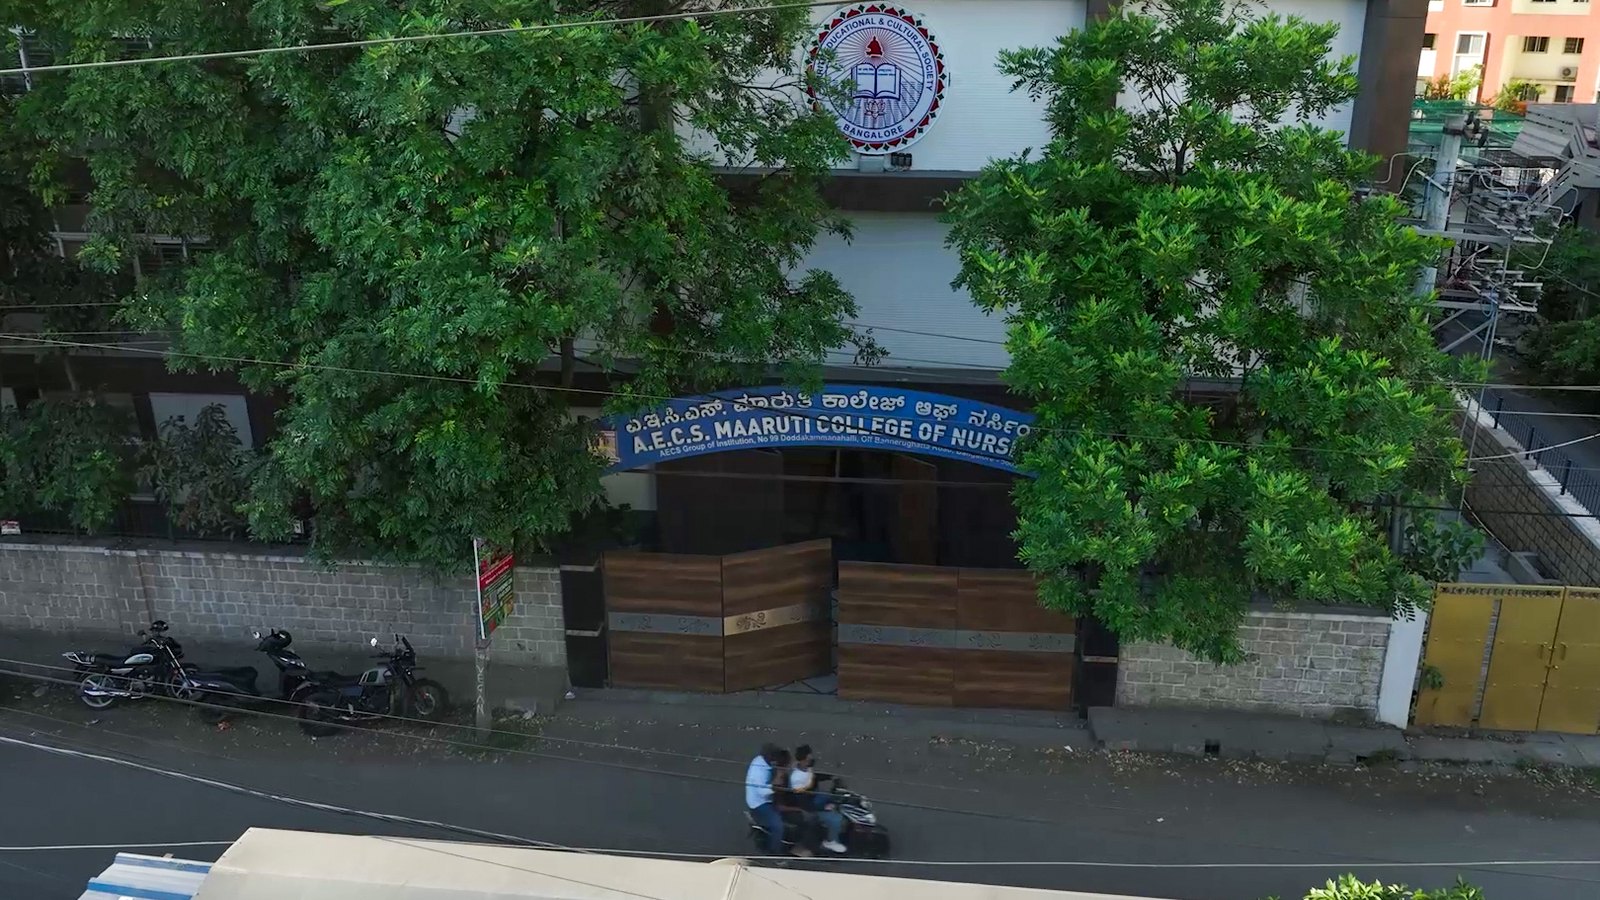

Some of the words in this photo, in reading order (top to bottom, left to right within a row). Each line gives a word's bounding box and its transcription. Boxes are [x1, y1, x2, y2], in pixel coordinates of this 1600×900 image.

[825, 17, 876, 50] DUCATIONAL
[879, 17, 885, 26] &
[887, 20, 923, 52] CULTURAL
[921, 51, 934, 92] SOCIETY
[843, 123, 904, 139] BANGALORE
[633, 426, 710, 454] A.E.C.S.
[714, 416, 810, 439] MAARUTI
[816, 415, 913, 438] COLLEGE
[918, 422, 947, 442] OF
[951, 427, 1016, 457] NURS
[660, 448, 682, 457] AECS
[682, 443, 705, 452] Group
[707, 441, 715, 449] of
[757, 435, 768, 444] No
